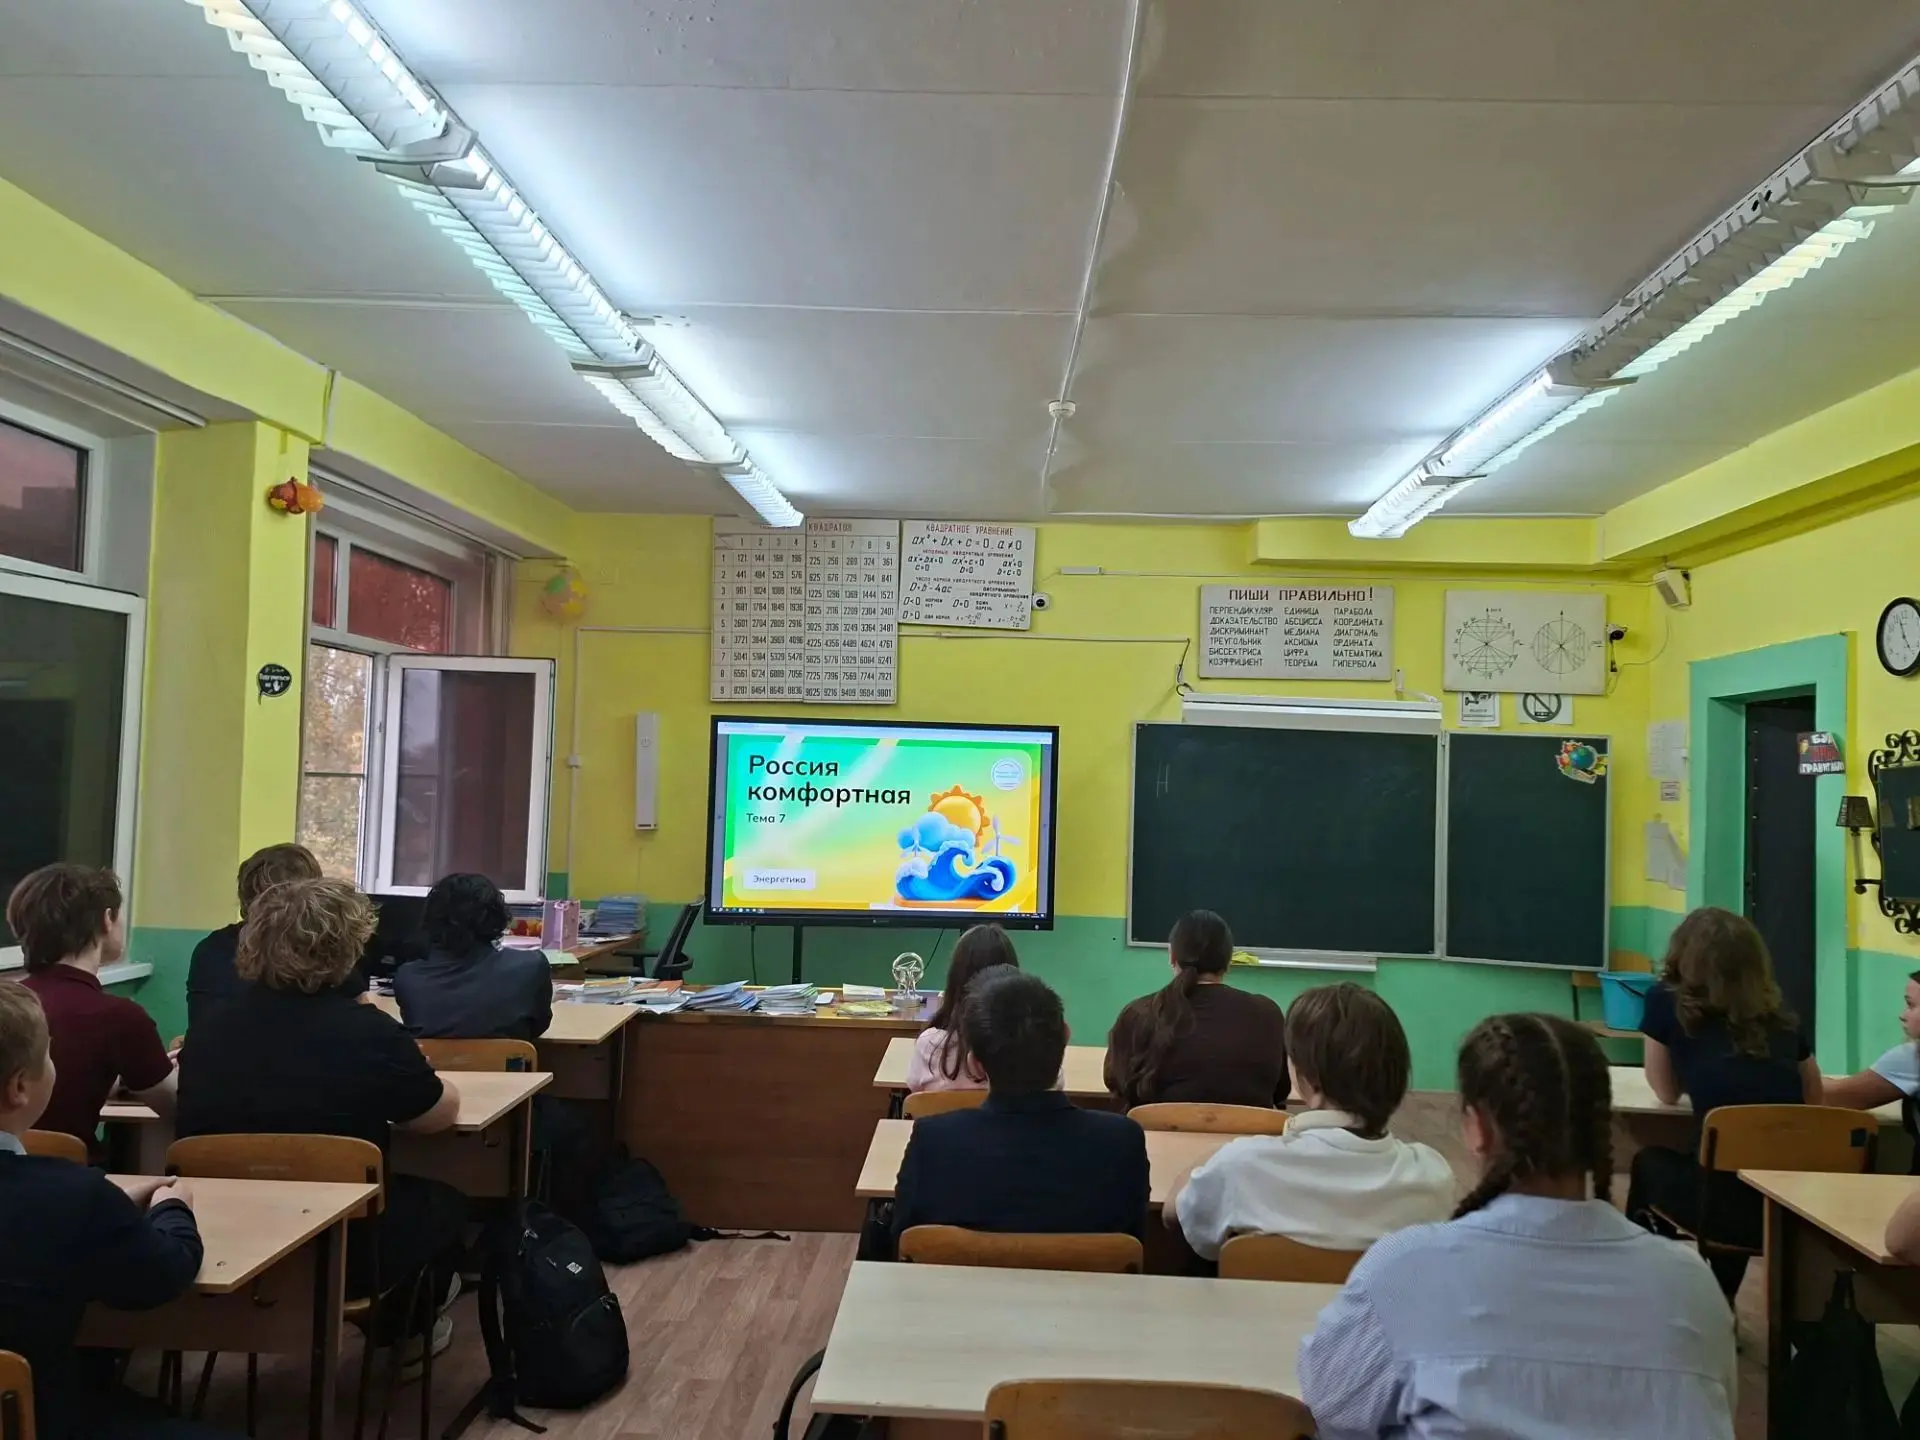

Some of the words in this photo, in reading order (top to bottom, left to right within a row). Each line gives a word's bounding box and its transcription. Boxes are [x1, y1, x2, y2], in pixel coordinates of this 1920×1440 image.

[926, 523, 970, 534] КВАДРАТНОЕ
[976, 525, 1014, 536] УРАВНЕНИЕ
[1229, 589, 1269, 601] ПИШИ
[1279, 586, 1373, 602] ПРАВИЛЬНО!
[1209, 606, 1274, 615] ПЕРПЕНДИКУЛЯР
[1284, 607, 1319, 616] ЕДИНИЦА
[1333, 607, 1374, 616] ПАРАБОЛА
[1209, 616, 1278, 625] ДОКАЗАТЕЛЬСТВО
[1284, 617, 1323, 626] АБСЦИССА
[1333, 617, 1383, 627] КООРДИНАТА
[1209, 627, 1269, 636] ДИСКРИМИНАНТ
[1284, 628, 1320, 637] МЕДИАНА
[1333, 628, 1379, 638] ДИАГОНАЛЬ
[1210, 637, 1263, 646] ТРЕУГОЛЬНИК
[1284, 638, 1319, 647] АКСИОМА
[1333, 638, 1374, 648] ОРДИНАТА
[1208, 647, 1262, 656] БИССЕКТРИСА
[1283, 648, 1309, 658] ЦИФРА
[1332, 649, 1383, 658] МАТЕМАТИКА
[1208, 658, 1263, 668] КОЭФФИЦИЕНТ
[1284, 659, 1318, 668] ТЕОРЕМА
[1332, 659, 1377, 668] ГИПЕРБОЛА
[749, 754, 839, 777] Россия
[747, 781, 911, 808] комфортная
[746, 812, 776, 823] Тема
[779, 813, 786, 823] 7
[752, 874, 807, 885] Энергетика
